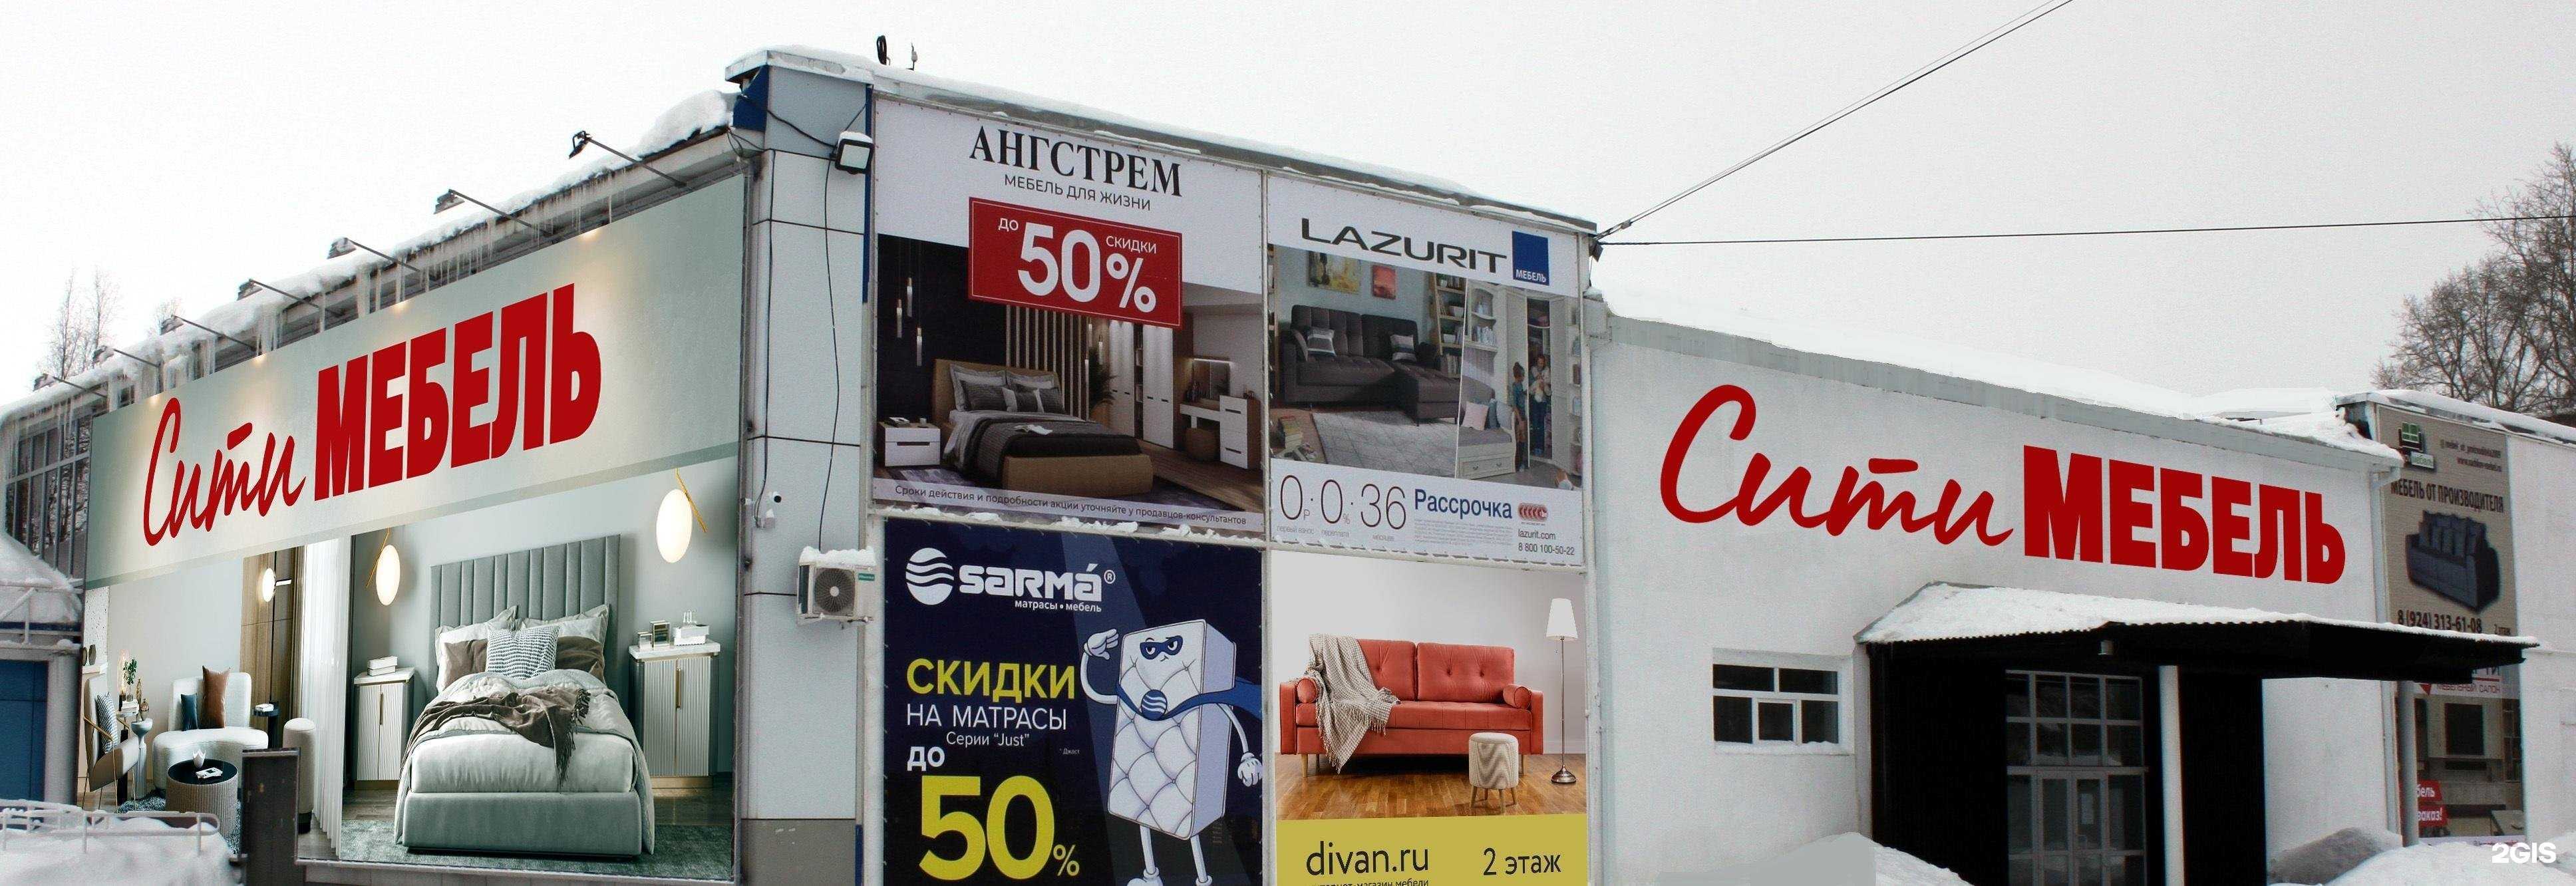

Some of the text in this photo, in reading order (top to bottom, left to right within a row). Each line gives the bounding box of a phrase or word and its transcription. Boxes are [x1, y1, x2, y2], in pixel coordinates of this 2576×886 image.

[969, 125, 1182, 197] АНГСТРЕМ
[1004, 174, 1151, 211] МЕБЕЛЬ ДЛЯ ЖИЗНИ
[1106, 235, 1157, 255] СКИДКИ
[1301, 218, 1507, 273] LAZURIT
[1017, 222, 1157, 313] 50%
[1516, 269, 1546, 283] МЕБЕЛЬ
[142, 283, 602, 547] Сити МЕБЕЛЬ
[1659, 384, 2346, 585] Сити МЕБЕЛЬ
[2391, 478, 2503, 513] МЕБЕЛЬ ОТ ПРОИЗВОДИТЕЛЯ
[895, 485, 926, 496] Сроки
[928, 490, 974, 501] действия
[986, 494, 1048, 508] подробности
[1050, 500, 1078, 510] акции
[1080, 504, 1126, 515] уточняйте
[1128, 508, 1134, 516] у
[1136, 508, 1247, 525] продавцов-консультантов
[1361, 484, 1406, 529] 36
[1414, 489, 1512, 519] Рассрочка
[1518, 529, 1556, 539] lazurit.com
[1518, 542, 1575, 555] 8 800 100-50-22
[1015, 600, 1102, 612] матрасы мебель
[2398, 609, 2482, 633] 8 (924) 313-61-08
[907, 658, 1075, 703] СКИДКИ
[2479, 684, 2500, 693] САЛОН
[907, 703, 1066, 730] НА МАТРАСЫ
[946, 731, 989, 748] Серии
[2416, 784, 2435, 798] бель
[919, 775, 1080, 881] 50%
[1306, 840, 1429, 876] divan.ru
[1483, 847, 1561, 876] 2 этаж
